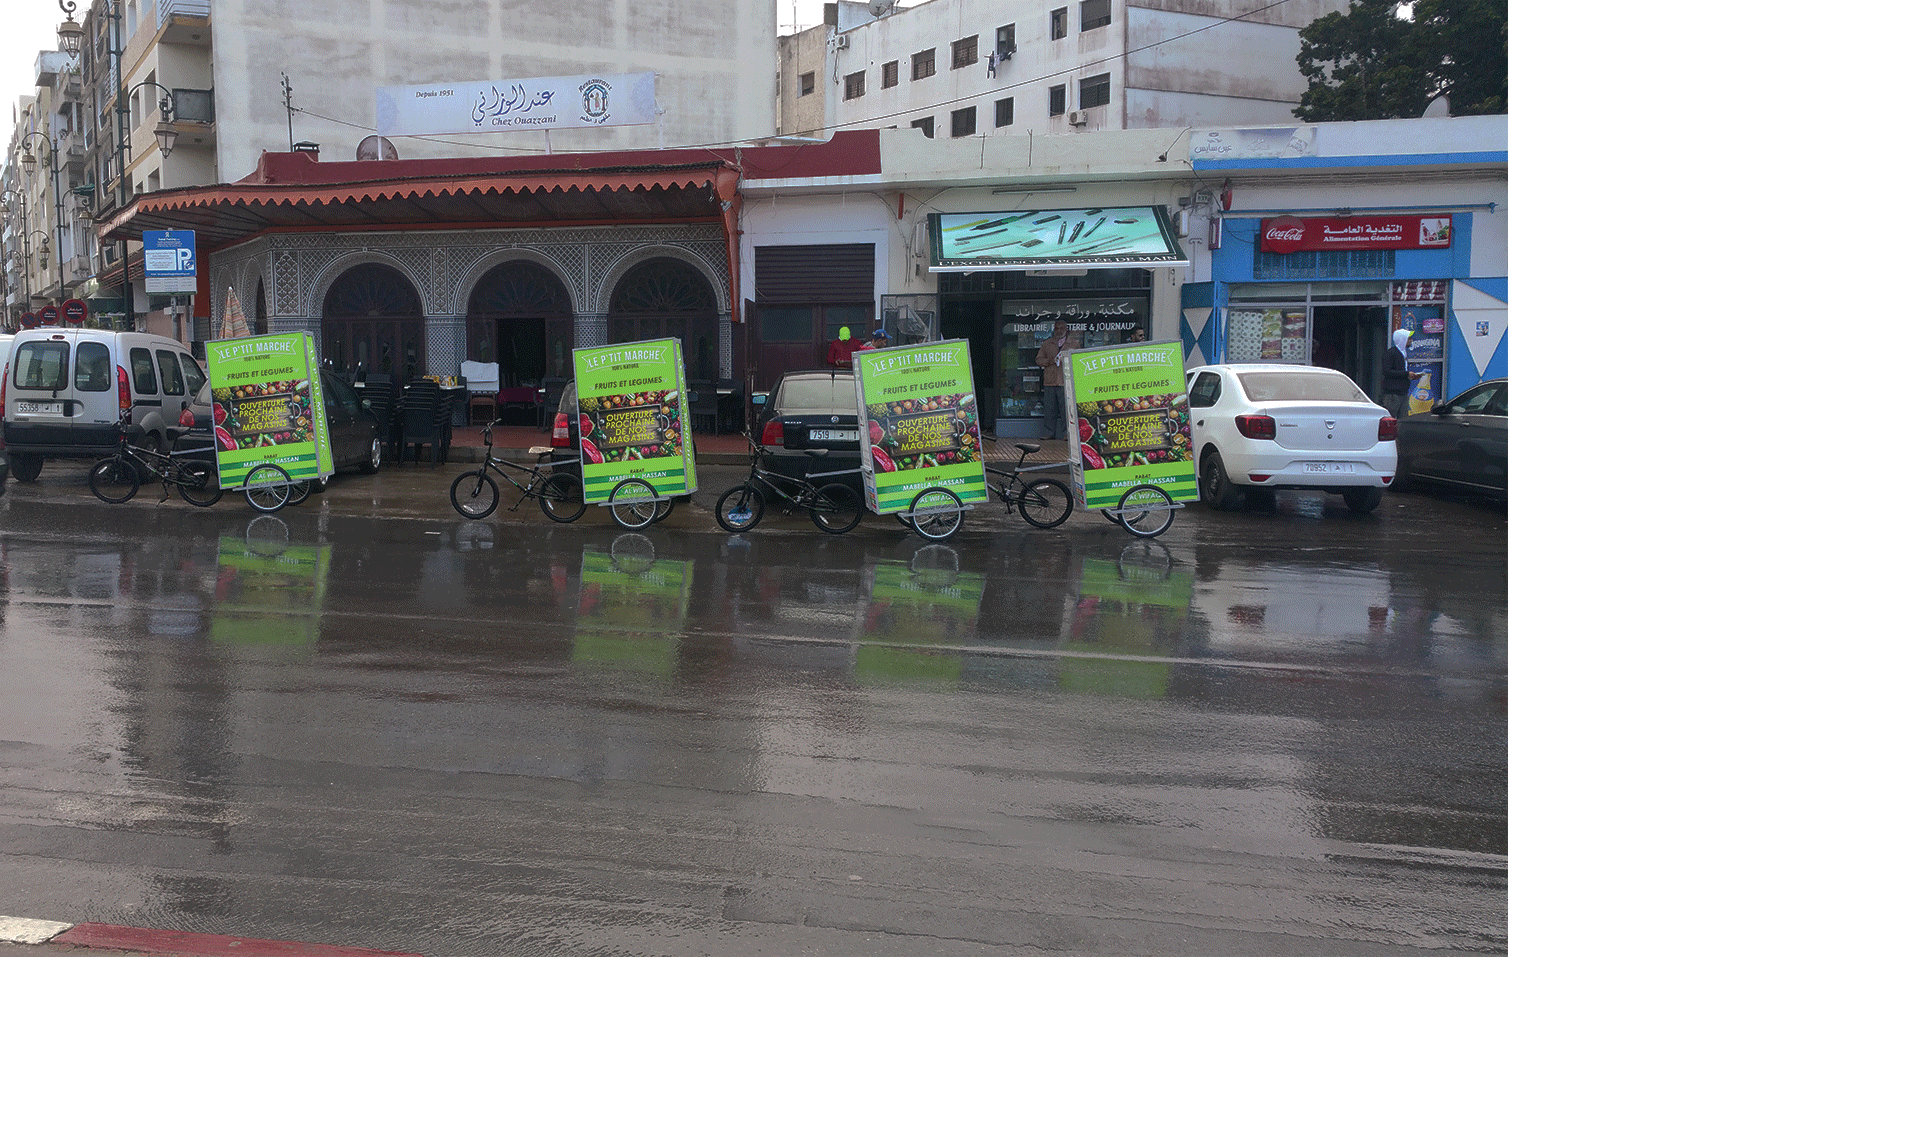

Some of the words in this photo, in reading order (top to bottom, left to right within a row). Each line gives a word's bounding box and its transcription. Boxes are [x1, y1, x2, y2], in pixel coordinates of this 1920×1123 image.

[415, 90, 437, 98] Depuis
[439, 89, 454, 97] 1951
[520, 90, 555, 113] عند
[491, 116, 512, 126] Chez
[514, 114, 557, 125] Ouazzani
[1013, 323, 1049, 332] LIBRAIRIE,
[1089, 323, 1095, 331] &
[220, 348, 230, 359] LE
[233, 343, 254, 356] P'TIT
[256, 340, 290, 352] MARCHÉ
[588, 357, 598, 368] LE
[601, 352, 622, 364] P'TIT
[624, 349, 660, 360] MARCHÉ
[875, 361, 887, 372] LE
[889, 355, 911, 368] P'TIT
[914, 350, 953, 363] MARCHÉ
[1086, 359, 1098, 371] LE
[1101, 354, 1124, 367] P'TIT
[1127, 351, 1167, 363] MARCHÉ
[227, 370, 249, 380] FRUITS
[251, 369, 259, 378] ET
[260, 367, 294, 377] LEGUMES
[594, 380, 617, 390] FRUITS
[619, 379, 627, 387] ET
[628, 375, 663, 386] LEGUMES
[883, 385, 908, 395] FRUITS
[909, 383, 918, 392] ET
[920, 379, 957, 390] LEGUMES
[1094, 384, 1119, 394] FRUITS
[1121, 383, 1129, 391] ET
[1131, 379, 1170, 390] LEGUMES
[239, 398, 286, 410] OUVERTURE
[239, 405, 287, 417] PROCHAINE
[606, 410, 653, 422] OUVERTURE
[248, 415, 259, 424] DE
[261, 412, 279, 422] NOS
[605, 418, 655, 429] PROCHAINE
[897, 415, 949, 427] OUVERTURE
[1107, 414, 1160, 427] OUVERTURE
[242, 419, 287, 431] MAGASINS
[615, 427, 625, 436] DE
[628, 424, 646, 434] NOS
[897, 422, 950, 436] PROCHAINE
[1107, 422, 1162, 434] PROCHAINE
[608, 432, 655, 444] MAGASINS
[813, 430, 829, 439] 7519
[908, 434, 920, 443] DE
[922, 431, 942, 440] NOS
[1118, 432, 1130, 441] DE
[1132, 430, 1153, 440] NOS
[901, 438, 951, 451] MAGASINS
[1110, 437, 1162, 449] MAGASINS
[275, 456, 300, 464] HASSAN
[641, 471, 667, 479] HASSAN
[902, 482, 932, 491] MABELLA
[938, 478, 965, 487] HASSAN
[1111, 480, 1142, 488] MABELLA
[1147, 477, 1176, 485] HASSAN
